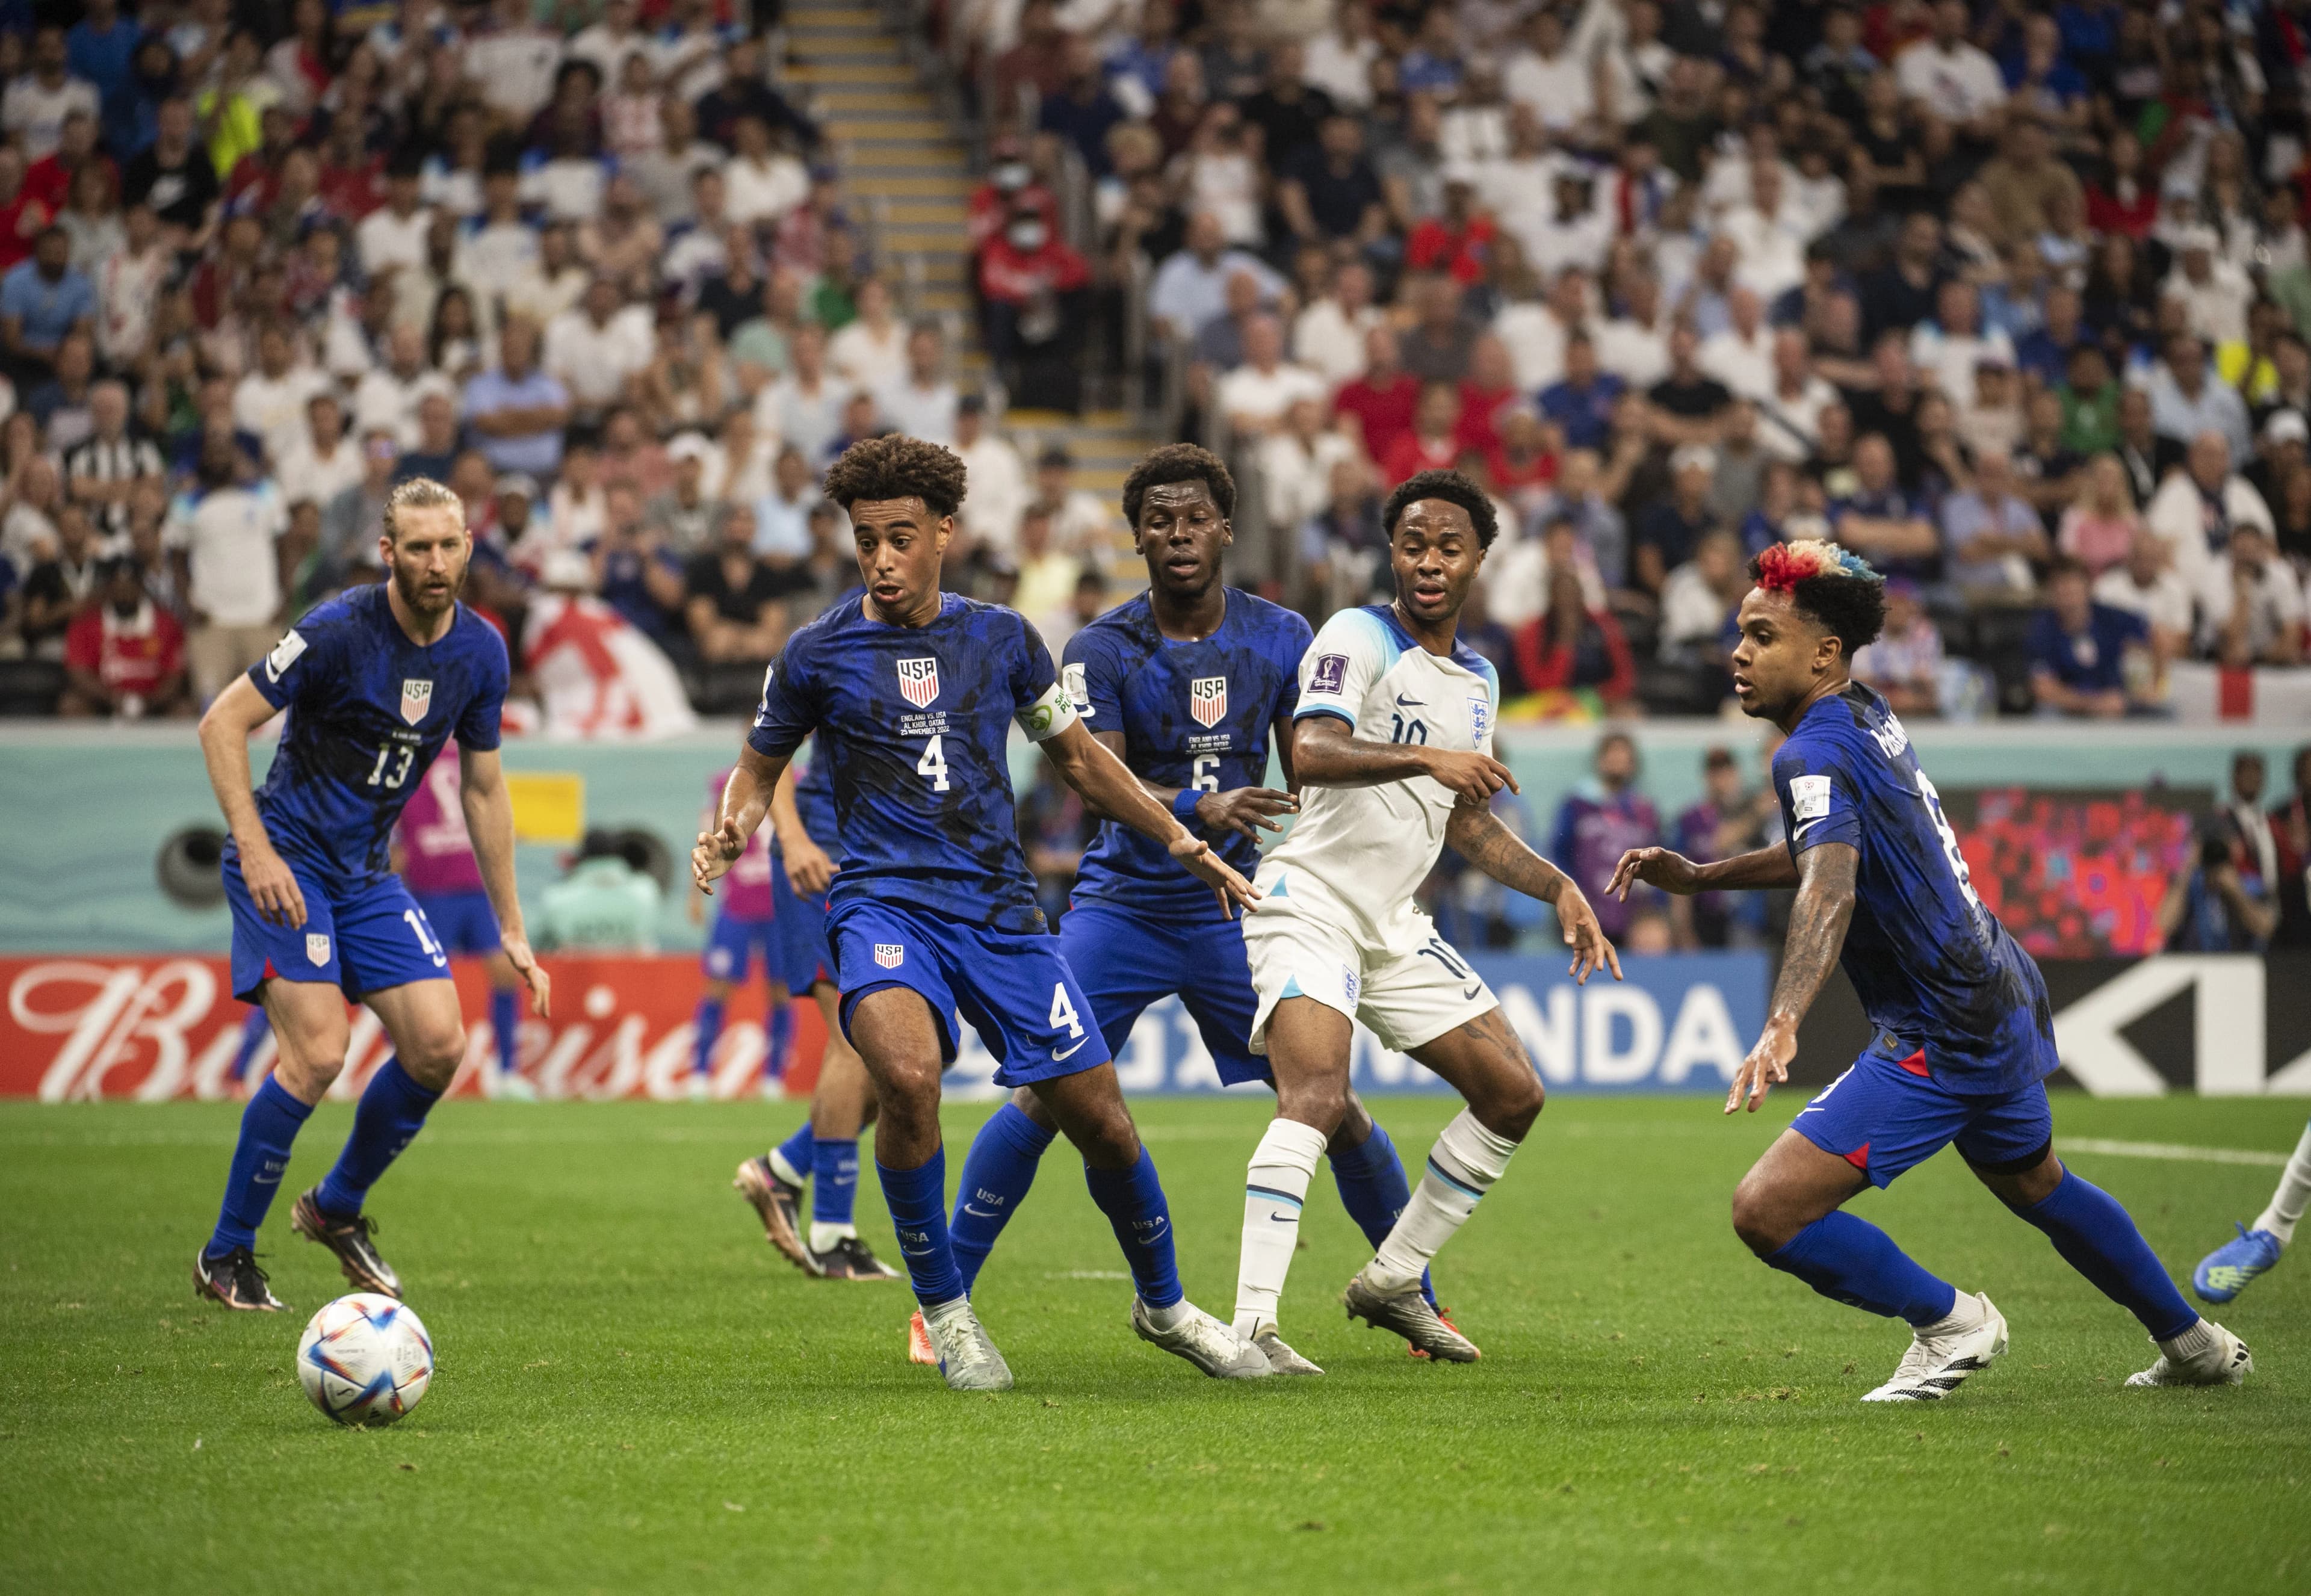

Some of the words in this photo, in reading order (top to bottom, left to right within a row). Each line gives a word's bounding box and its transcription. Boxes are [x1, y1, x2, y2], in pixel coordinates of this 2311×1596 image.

[900, 661, 934, 679] USA
[406, 684, 430, 699] USA
[1195, 680, 1223, 699] USA
[901, 714, 926, 722] ENGLAND
[1391, 713, 1427, 745] 10
[367, 743, 414, 788] 13
[918, 735, 949, 791] 4
[1192, 754, 1220, 793] 6
[877, 945, 901, 955] USA
[1049, 982, 1084, 1039] 4
[977, 1187, 1004, 1205] USA
[1132, 1216, 1165, 1230] USA
[900, 1230, 929, 1243] USA
